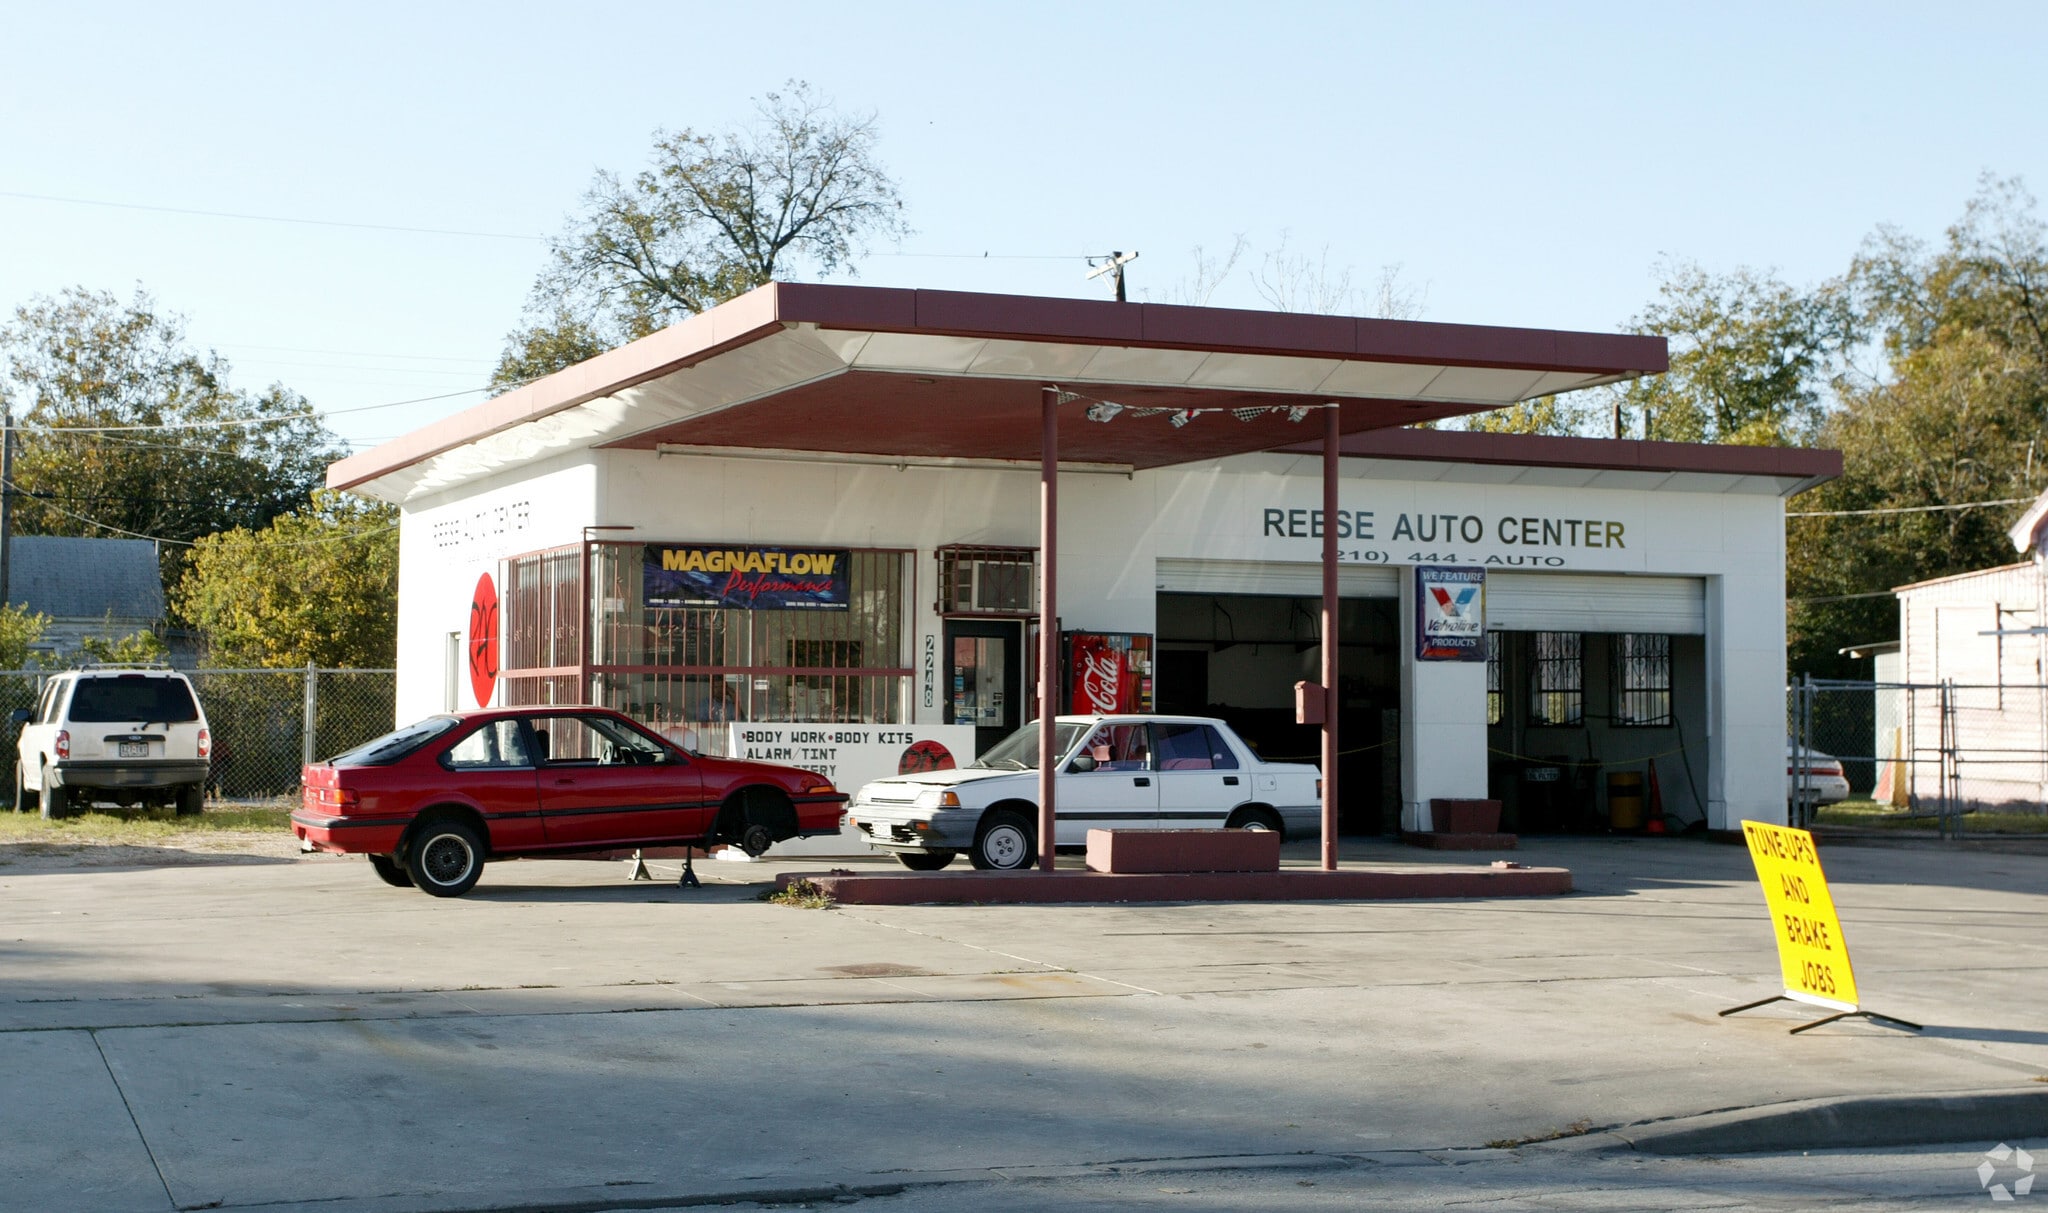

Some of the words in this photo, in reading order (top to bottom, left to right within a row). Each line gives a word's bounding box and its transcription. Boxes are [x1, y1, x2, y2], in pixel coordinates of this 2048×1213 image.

[1264, 508, 1375, 540] REESE
[1391, 513, 1483, 544] AUTO
[1498, 516, 1626, 549] CENTER
[662, 549, 836, 575] MAGNAFLOW
[1321, 550, 1390, 564] (210)
[722, 567, 833, 599] Performance
[1423, 571, 1439, 580] WE
[1440, 571, 1484, 581] FEATURE
[1428, 619, 1479, 632] Valvoline
[1431, 638, 1477, 647] PRODUCTS
[924, 634, 935, 708] 2248
[746, 731, 783, 743] BODY
[790, 731, 827, 744] WORK
[834, 731, 870, 744] BODY
[878, 732, 914, 744] KITS
[746, 748, 838, 761] ALARM/TINT
[1747, 826, 1815, 865] TUNE-UPS
[1780, 873, 1810, 905] AND
[1784, 914, 1832, 951] BRAKE
[1800, 960, 1836, 995] JOBS
